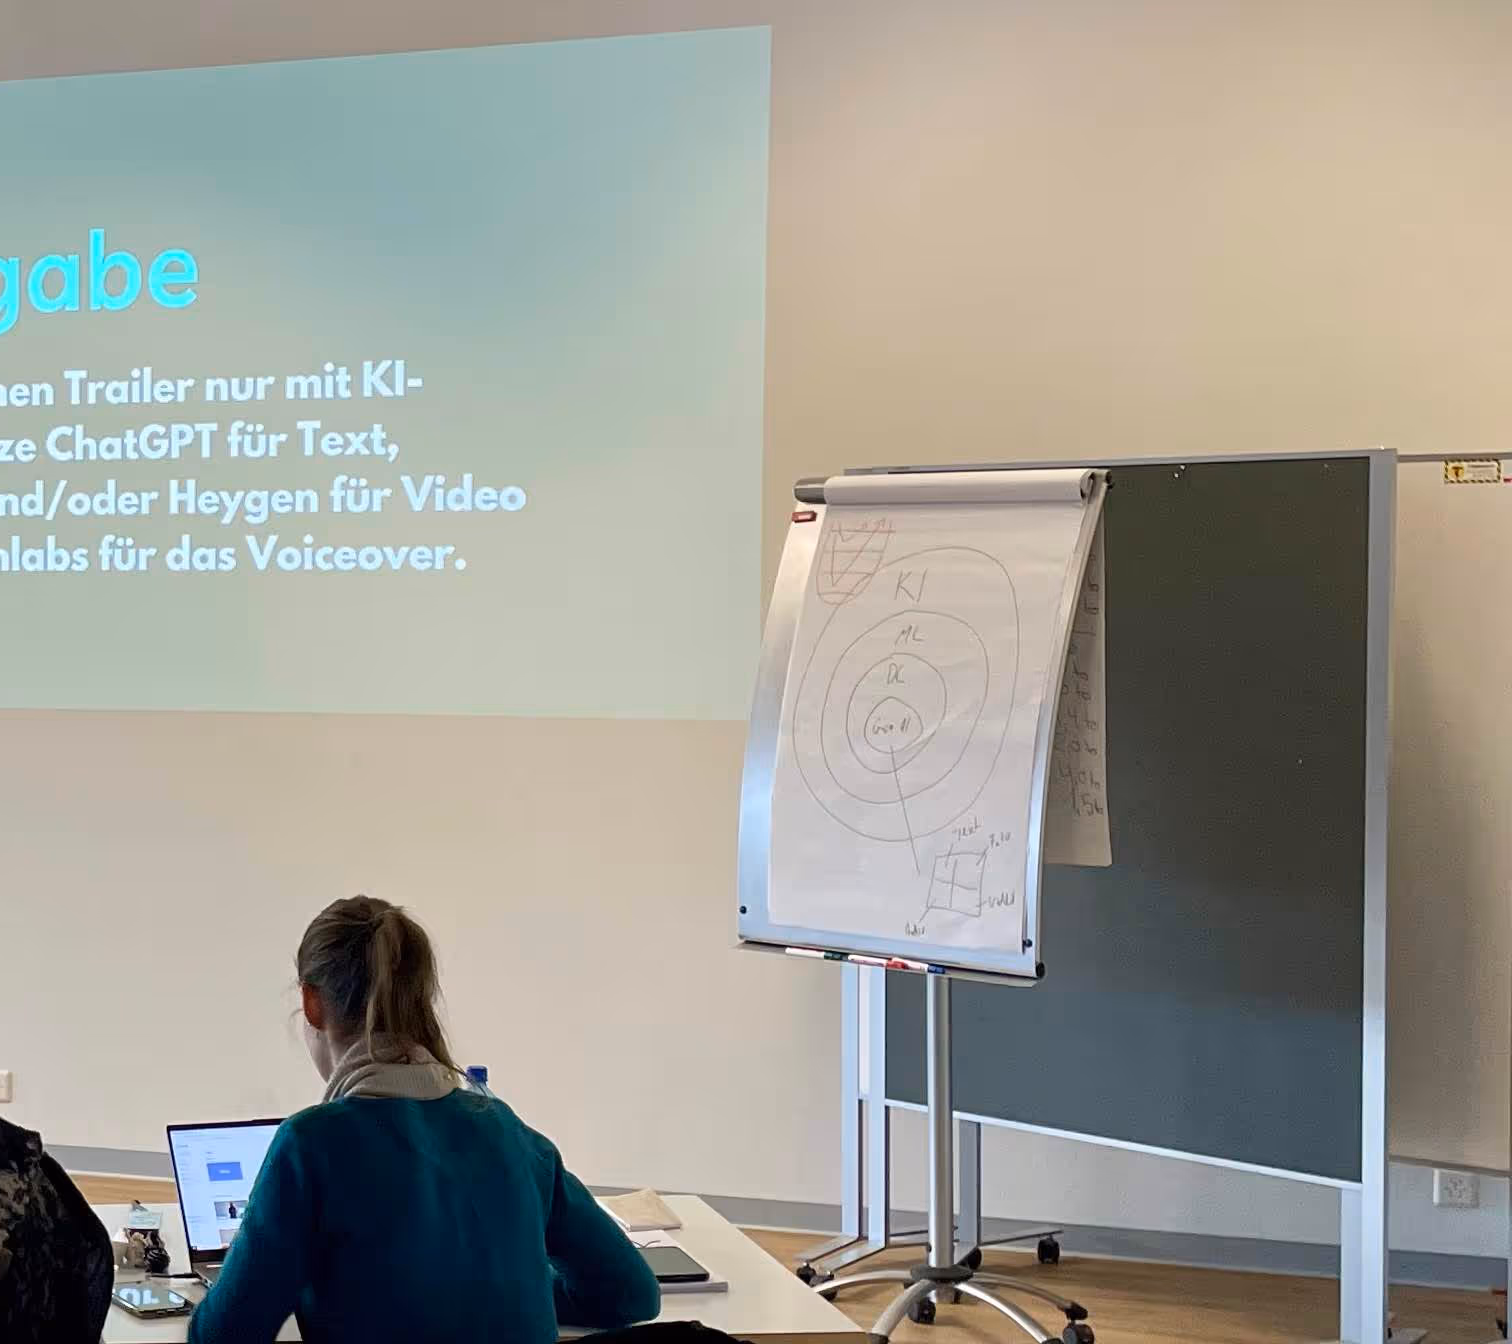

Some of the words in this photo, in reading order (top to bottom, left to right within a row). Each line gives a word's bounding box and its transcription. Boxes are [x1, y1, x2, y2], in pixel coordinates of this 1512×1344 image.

[64, 367, 195, 405] Trailer
[204, 374, 275, 402] nur
[284, 362, 353, 400] mit
[361, 360, 424, 397] KI-
[46, 423, 218, 462] ChatGPT
[226, 419, 289, 458] für
[295, 419, 400, 463] Text,
[167, 478, 320, 525] Heygen
[329, 474, 393, 513] für
[399, 472, 527, 513] Video
[97, 534, 158, 572] für
[164, 533, 237, 572] das
[245, 534, 467, 572] Voiceover.
[894, 568, 928, 603] KI
